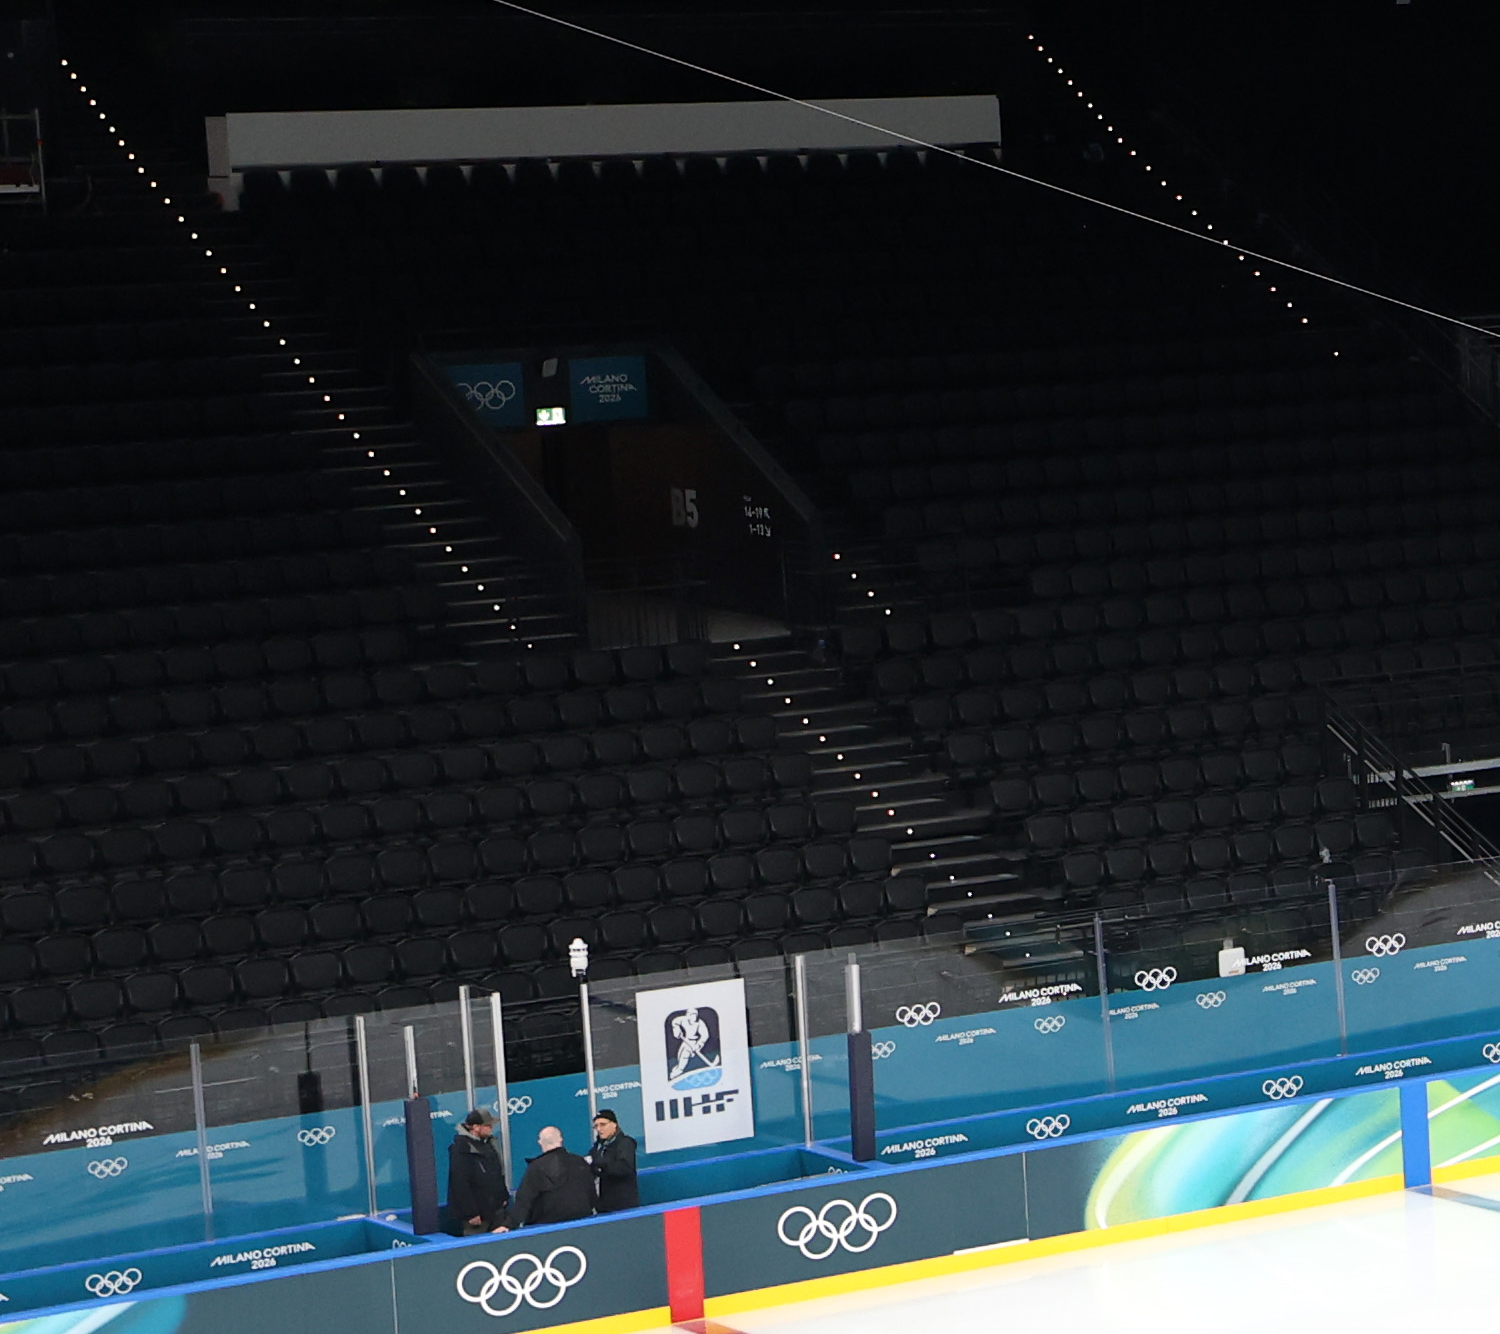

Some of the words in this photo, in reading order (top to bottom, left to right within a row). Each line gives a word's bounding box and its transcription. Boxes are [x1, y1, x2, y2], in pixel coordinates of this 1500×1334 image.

[579, 373, 628, 385] MILANO
[670, 488, 699, 528] B5
[1456, 921, 1494, 935] MILANO
[1232, 954, 1270, 968] MILANO
[1271, 949, 1312, 961] CORTINA
[1263, 962, 1282, 972] 2026
[999, 989, 1040, 1003] MILANO
[1040, 983, 1083, 996] CORTINA
[1031, 997, 1051, 1006] 2026
[1355, 1062, 1393, 1076] MILANO
[1393, 1056, 1432, 1070] CORTINA
[1384, 1069, 1403, 1080] 2026
[655, 1089, 739, 1122] IIHF
[1126, 1099, 1167, 1114] MILANO
[1167, 1093, 1208, 1108] CORTINA
[1158, 1106, 1178, 1117] 2026
[43, 1127, 96, 1145] MILANO
[98, 1120, 154, 1136] CORTINA
[86, 1137, 113, 1149] 2026
[880, 1140, 924, 1155] MILANO
[925, 1133, 969, 1147] CORTINA
[915, 1148, 936, 1158] 2026
[211, 1250, 262, 1267] MILANO
[263, 1242, 315, 1258] CORTINA
[251, 1257, 277, 1269] 2026
